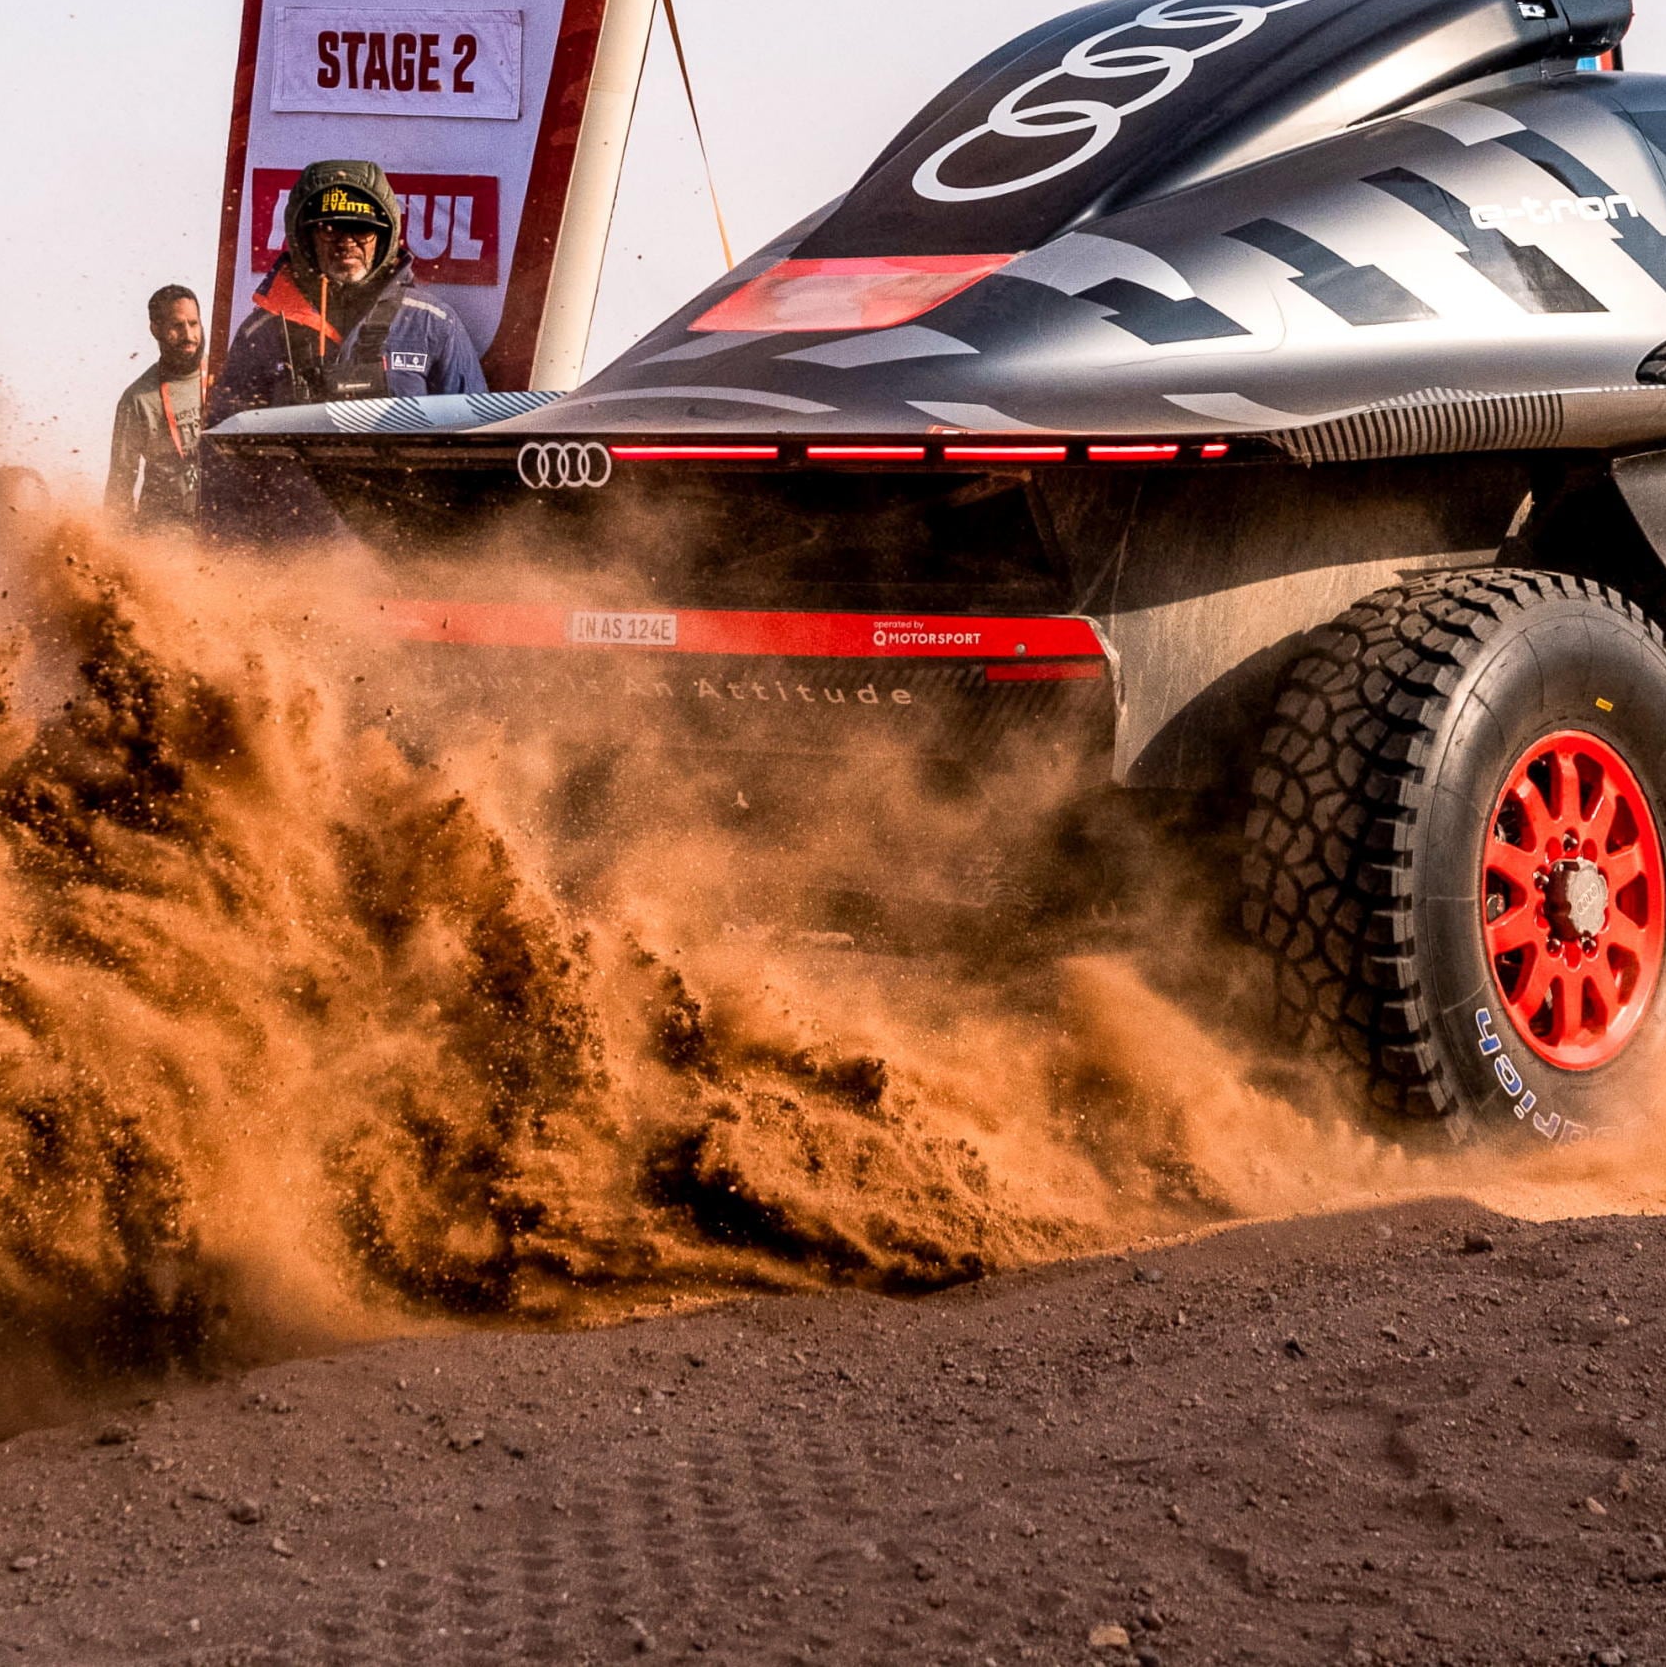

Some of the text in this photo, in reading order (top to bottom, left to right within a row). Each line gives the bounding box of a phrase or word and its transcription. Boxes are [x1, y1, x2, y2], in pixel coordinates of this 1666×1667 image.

[317, 30, 478, 94] STAGE 2
[1469, 194, 1639, 230] e-tron
[578, 617, 671, 640] IN AS 124E
[874, 620, 924, 630] operated by
[697, 678, 913, 705] Attitude
